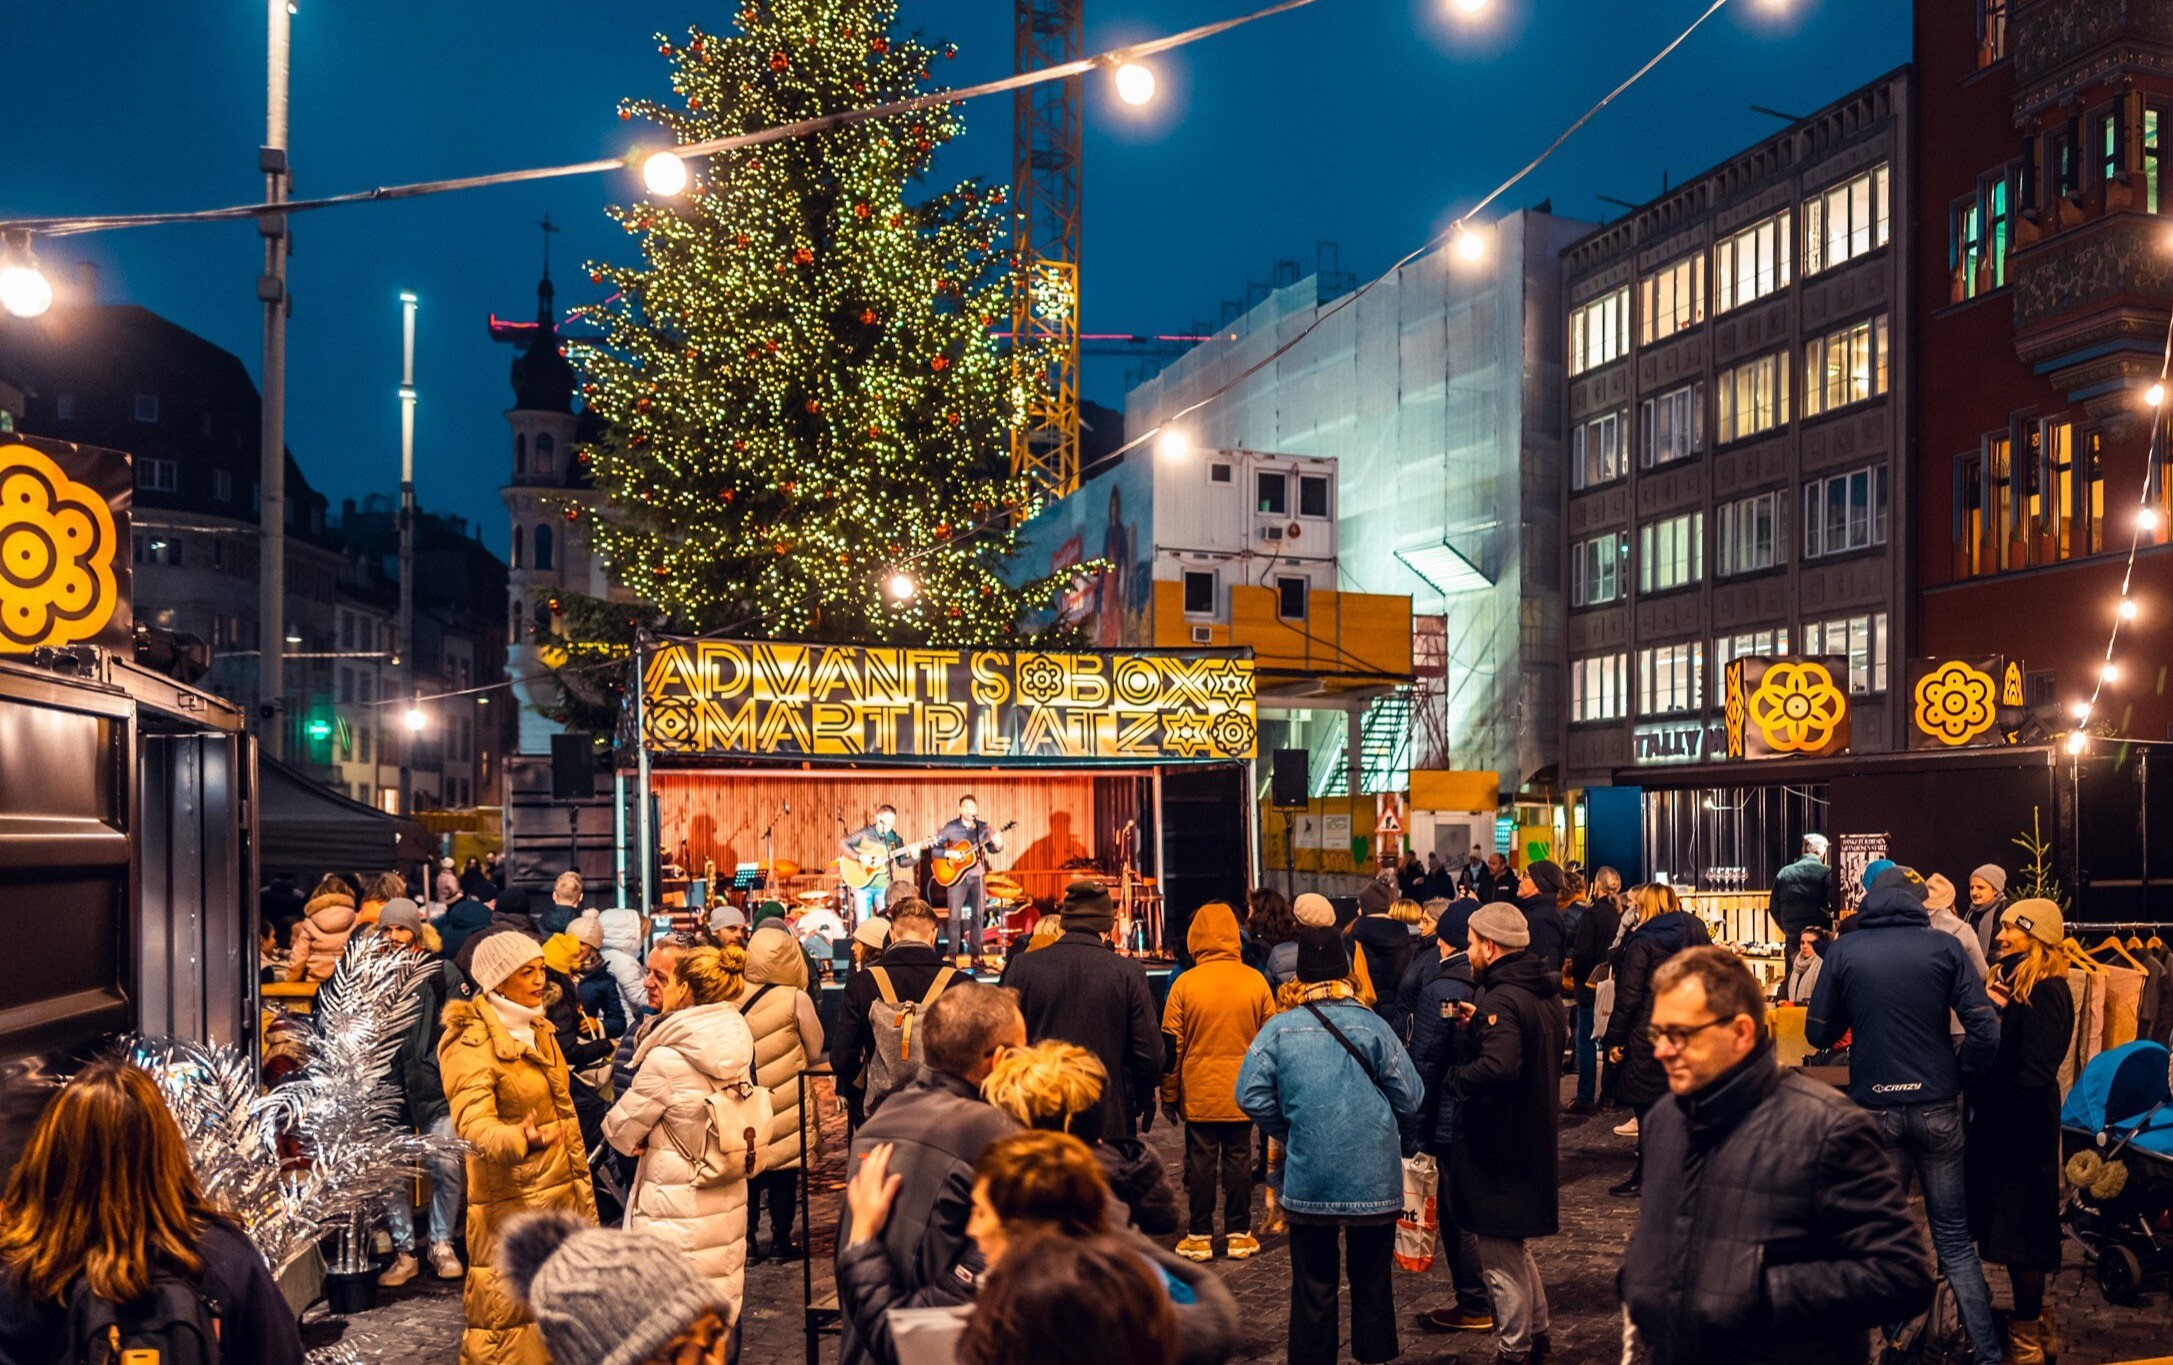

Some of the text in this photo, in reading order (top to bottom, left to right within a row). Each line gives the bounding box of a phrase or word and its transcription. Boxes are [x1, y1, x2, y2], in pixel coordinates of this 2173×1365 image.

[1070, 654, 1208, 709] BOX
[1634, 729, 1702, 758] TALLY
[1884, 1082, 1922, 1092] CRAZY
